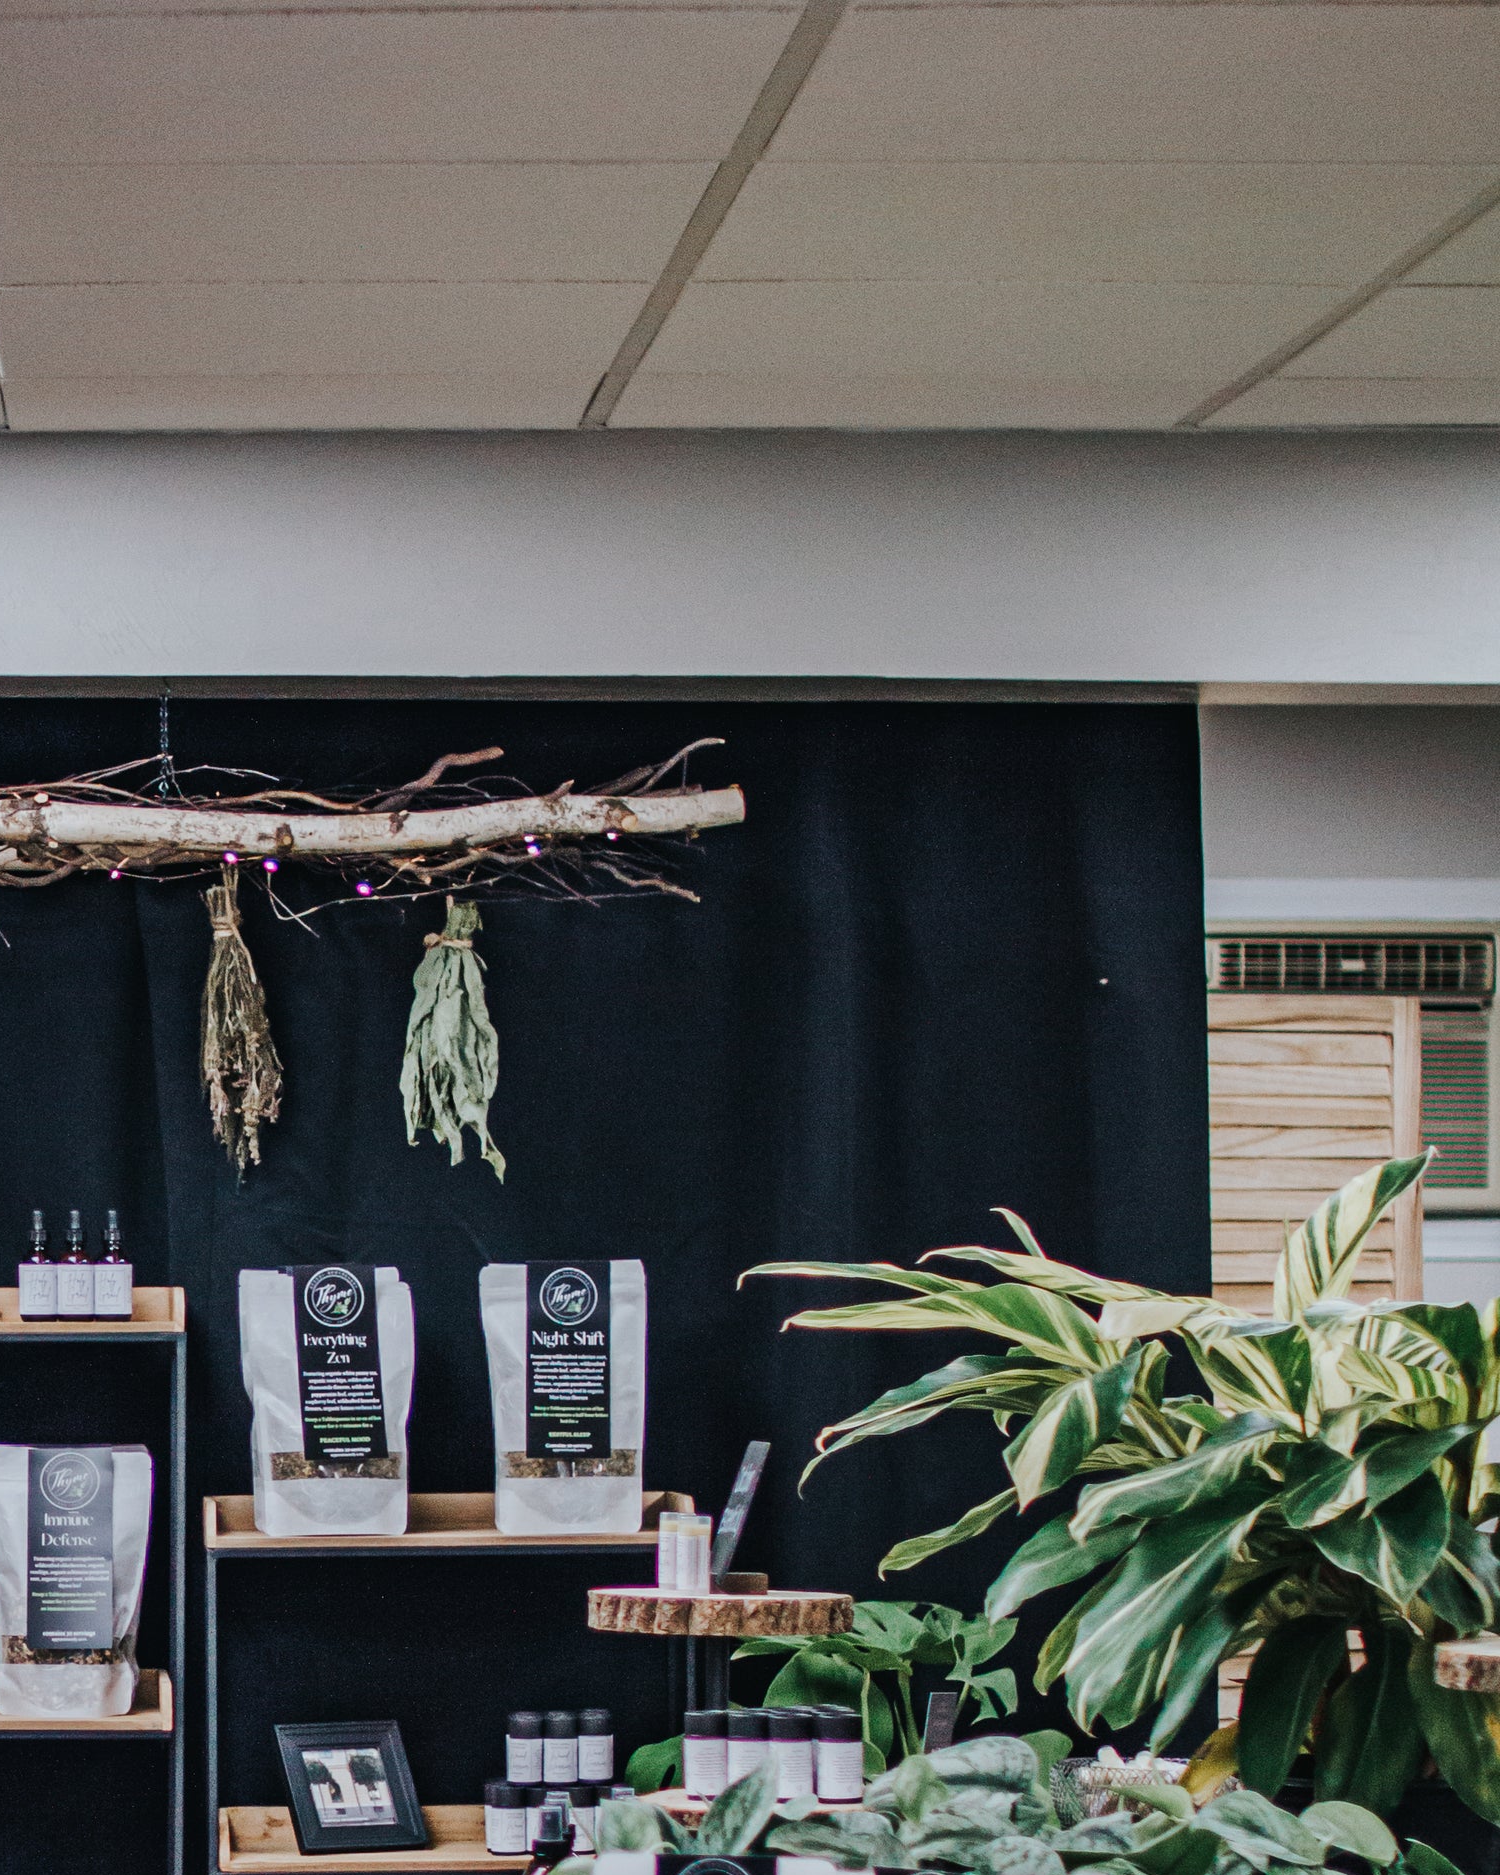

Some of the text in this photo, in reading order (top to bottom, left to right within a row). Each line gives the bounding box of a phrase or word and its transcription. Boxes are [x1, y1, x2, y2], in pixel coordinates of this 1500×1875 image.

[315, 1284, 353, 1313] Thyme
[550, 1283, 587, 1312] Thyme
[303, 1332, 367, 1349] Everything
[532, 1331, 605, 1348] Night Shift
[326, 1351, 350, 1364] Zen
[51, 1467, 88, 1497] Thyme
[44, 1512, 94, 1527] Immune
[41, 1532, 97, 1546] Defense
